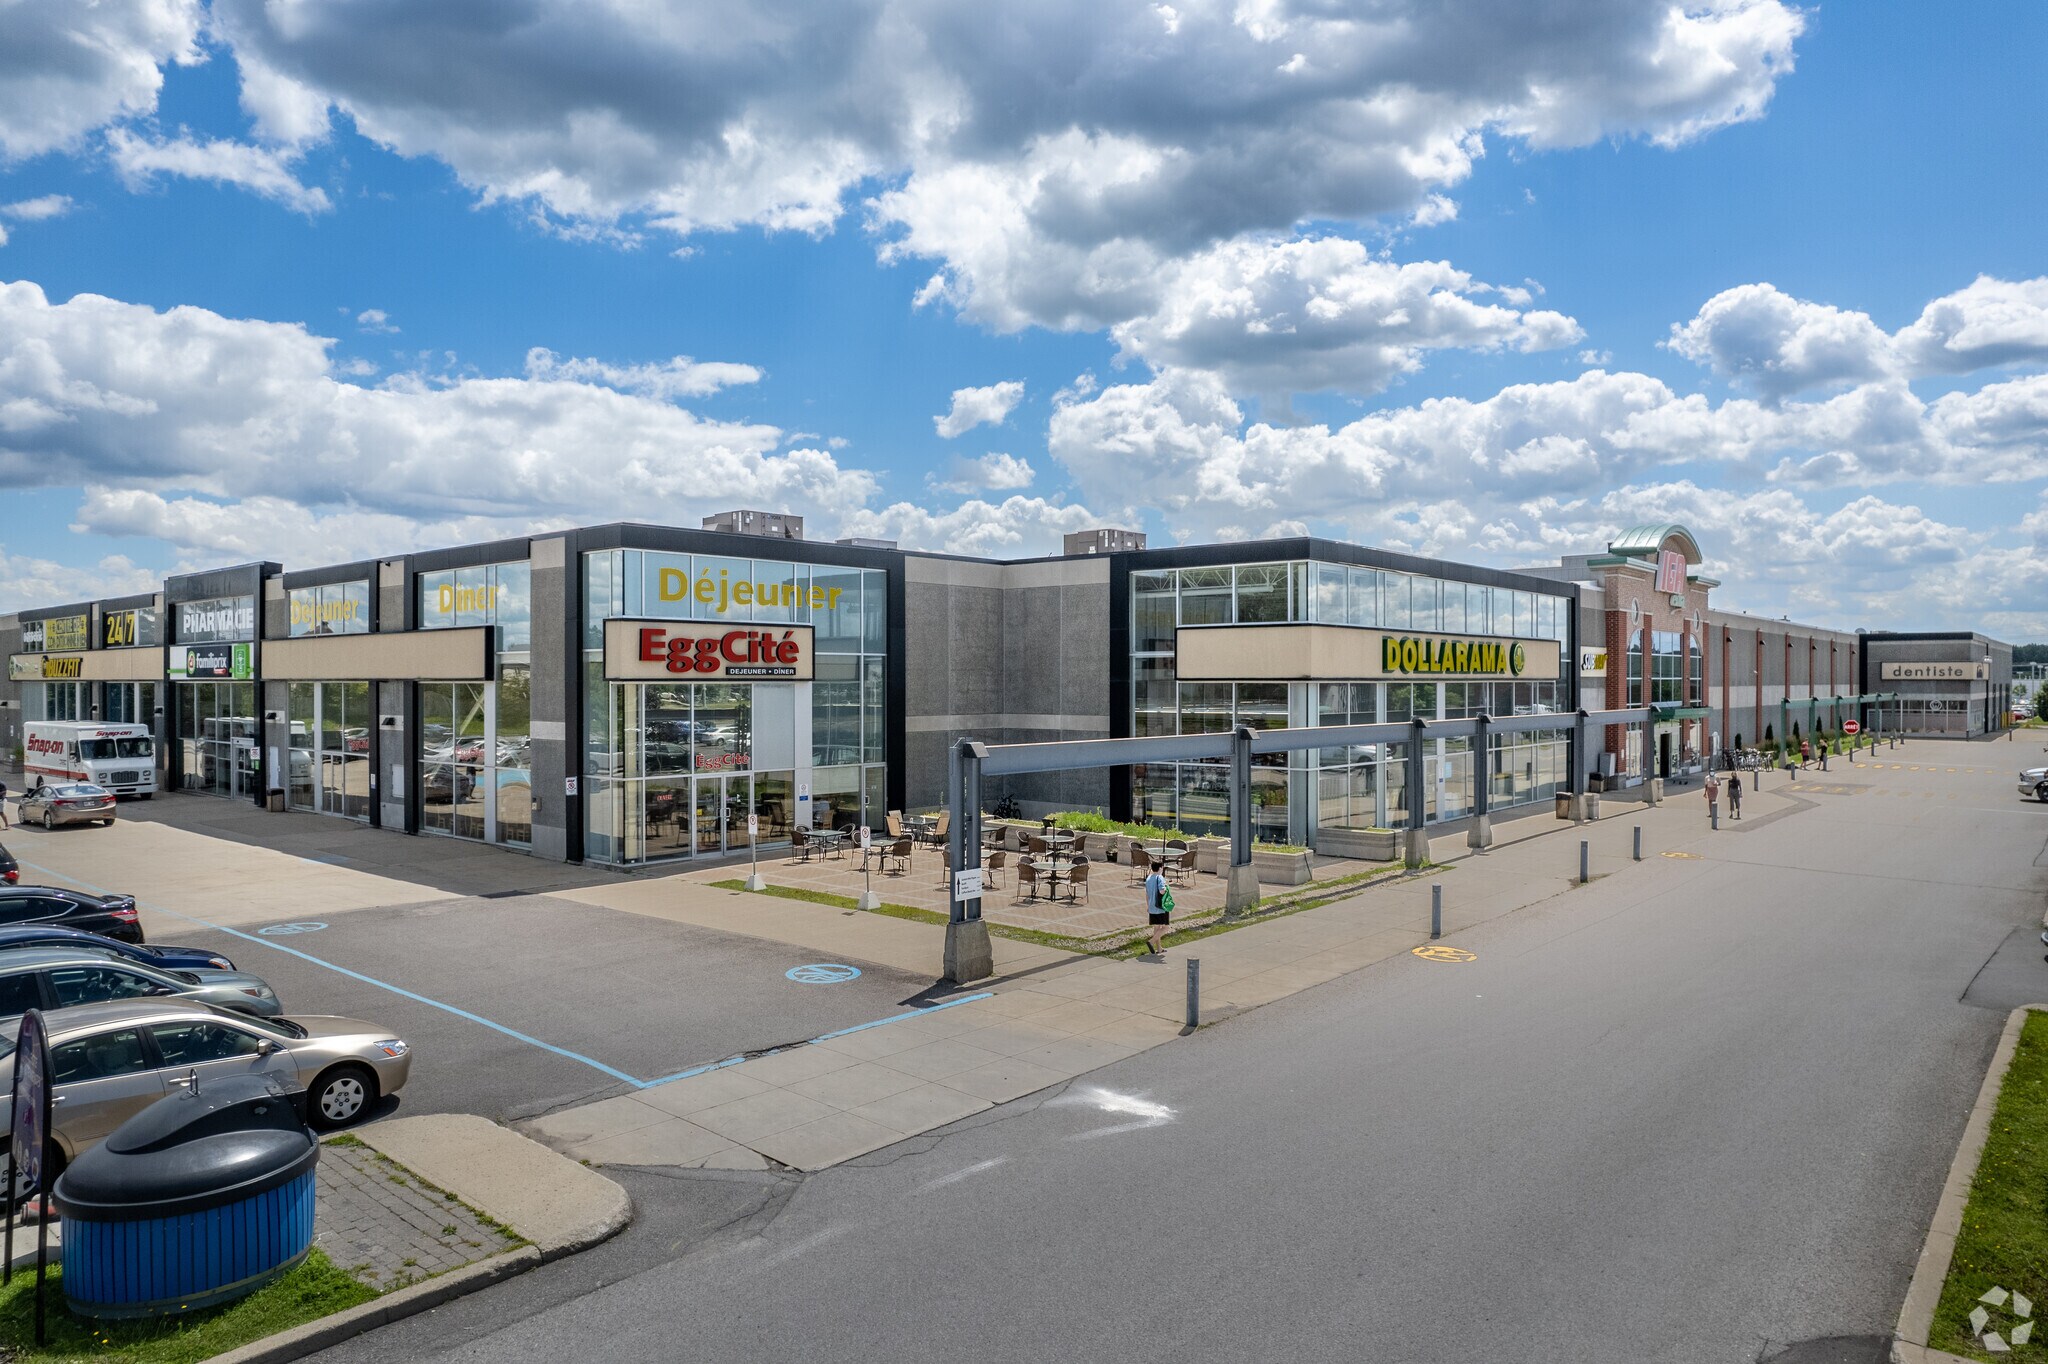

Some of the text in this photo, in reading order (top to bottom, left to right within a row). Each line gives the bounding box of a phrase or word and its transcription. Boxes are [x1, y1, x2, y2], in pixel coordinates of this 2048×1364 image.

[1660, 550, 1686, 595] IGA
[658, 567, 843, 614] Déjeuner
[107, 613, 135, 644] 24/7
[183, 607, 254, 634] PHARMACIE
[639, 628, 800, 673] EggCité
[1382, 636, 1508, 674] DOLLARAMA
[44, 657, 83, 678] BUZZFIT
[1893, 665, 1963, 677] dentiste
[27, 733, 64, 756] Snap-on
[695, 751, 750, 770] EggCité
